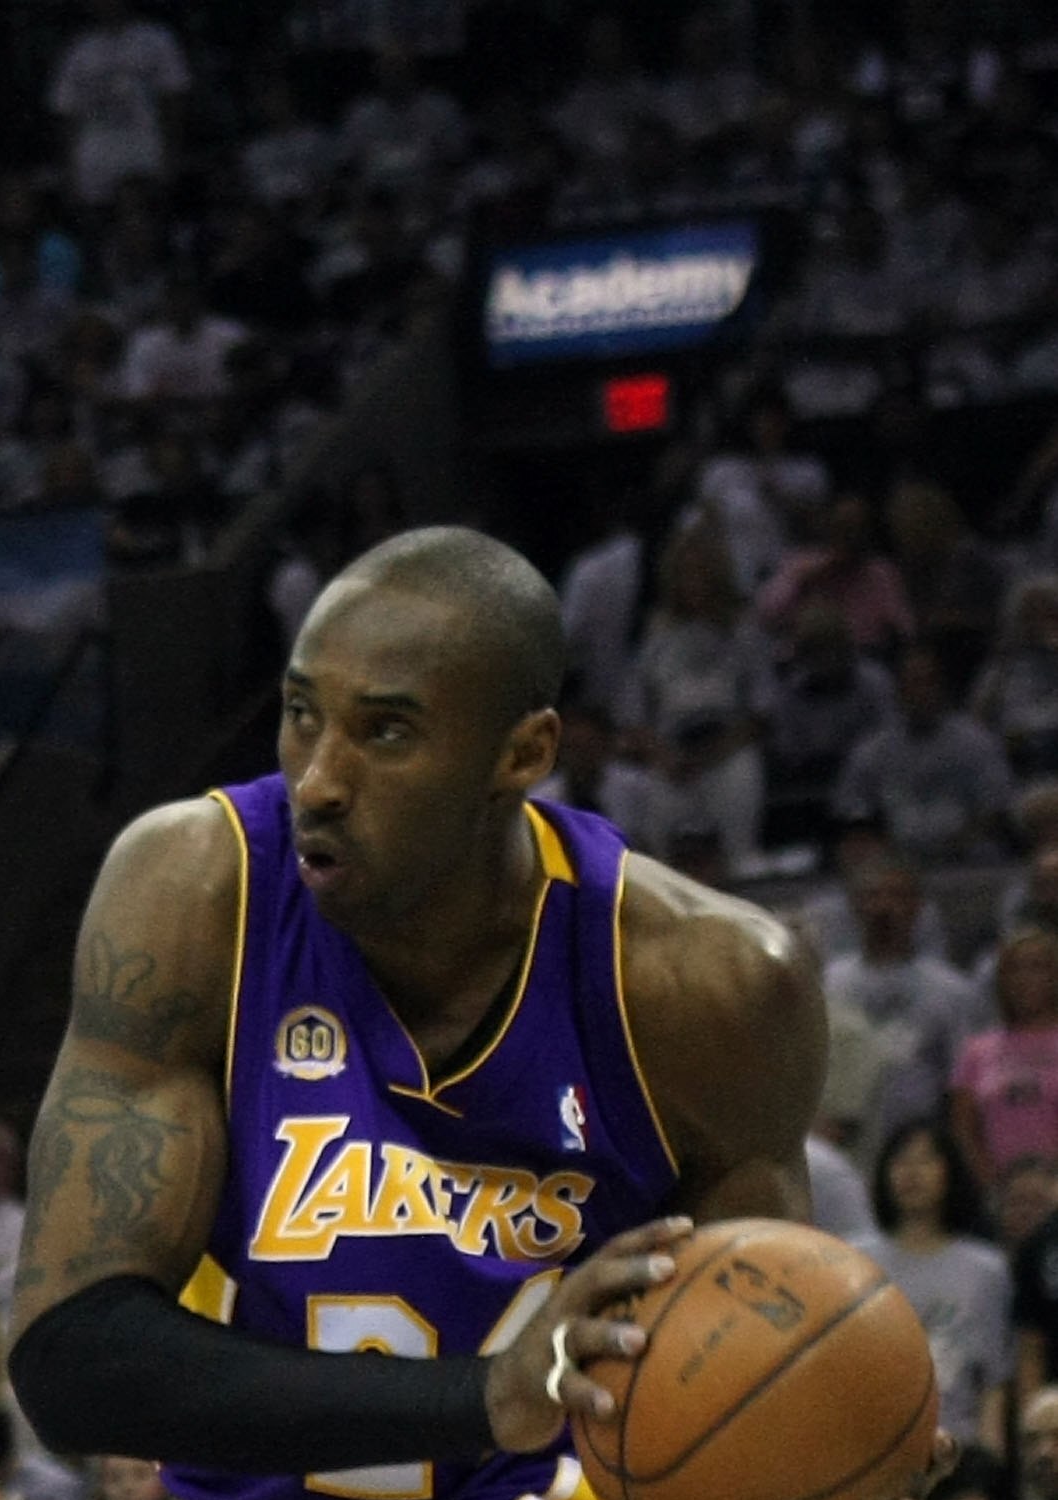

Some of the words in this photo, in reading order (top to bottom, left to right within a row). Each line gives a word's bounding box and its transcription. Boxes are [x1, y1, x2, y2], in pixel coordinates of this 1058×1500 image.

[490, 251, 752, 322] Academy
[289, 1023, 333, 1060] 60
[248, 1115, 596, 1263] LAKERS
[304, 1267, 564, 1500] 2
